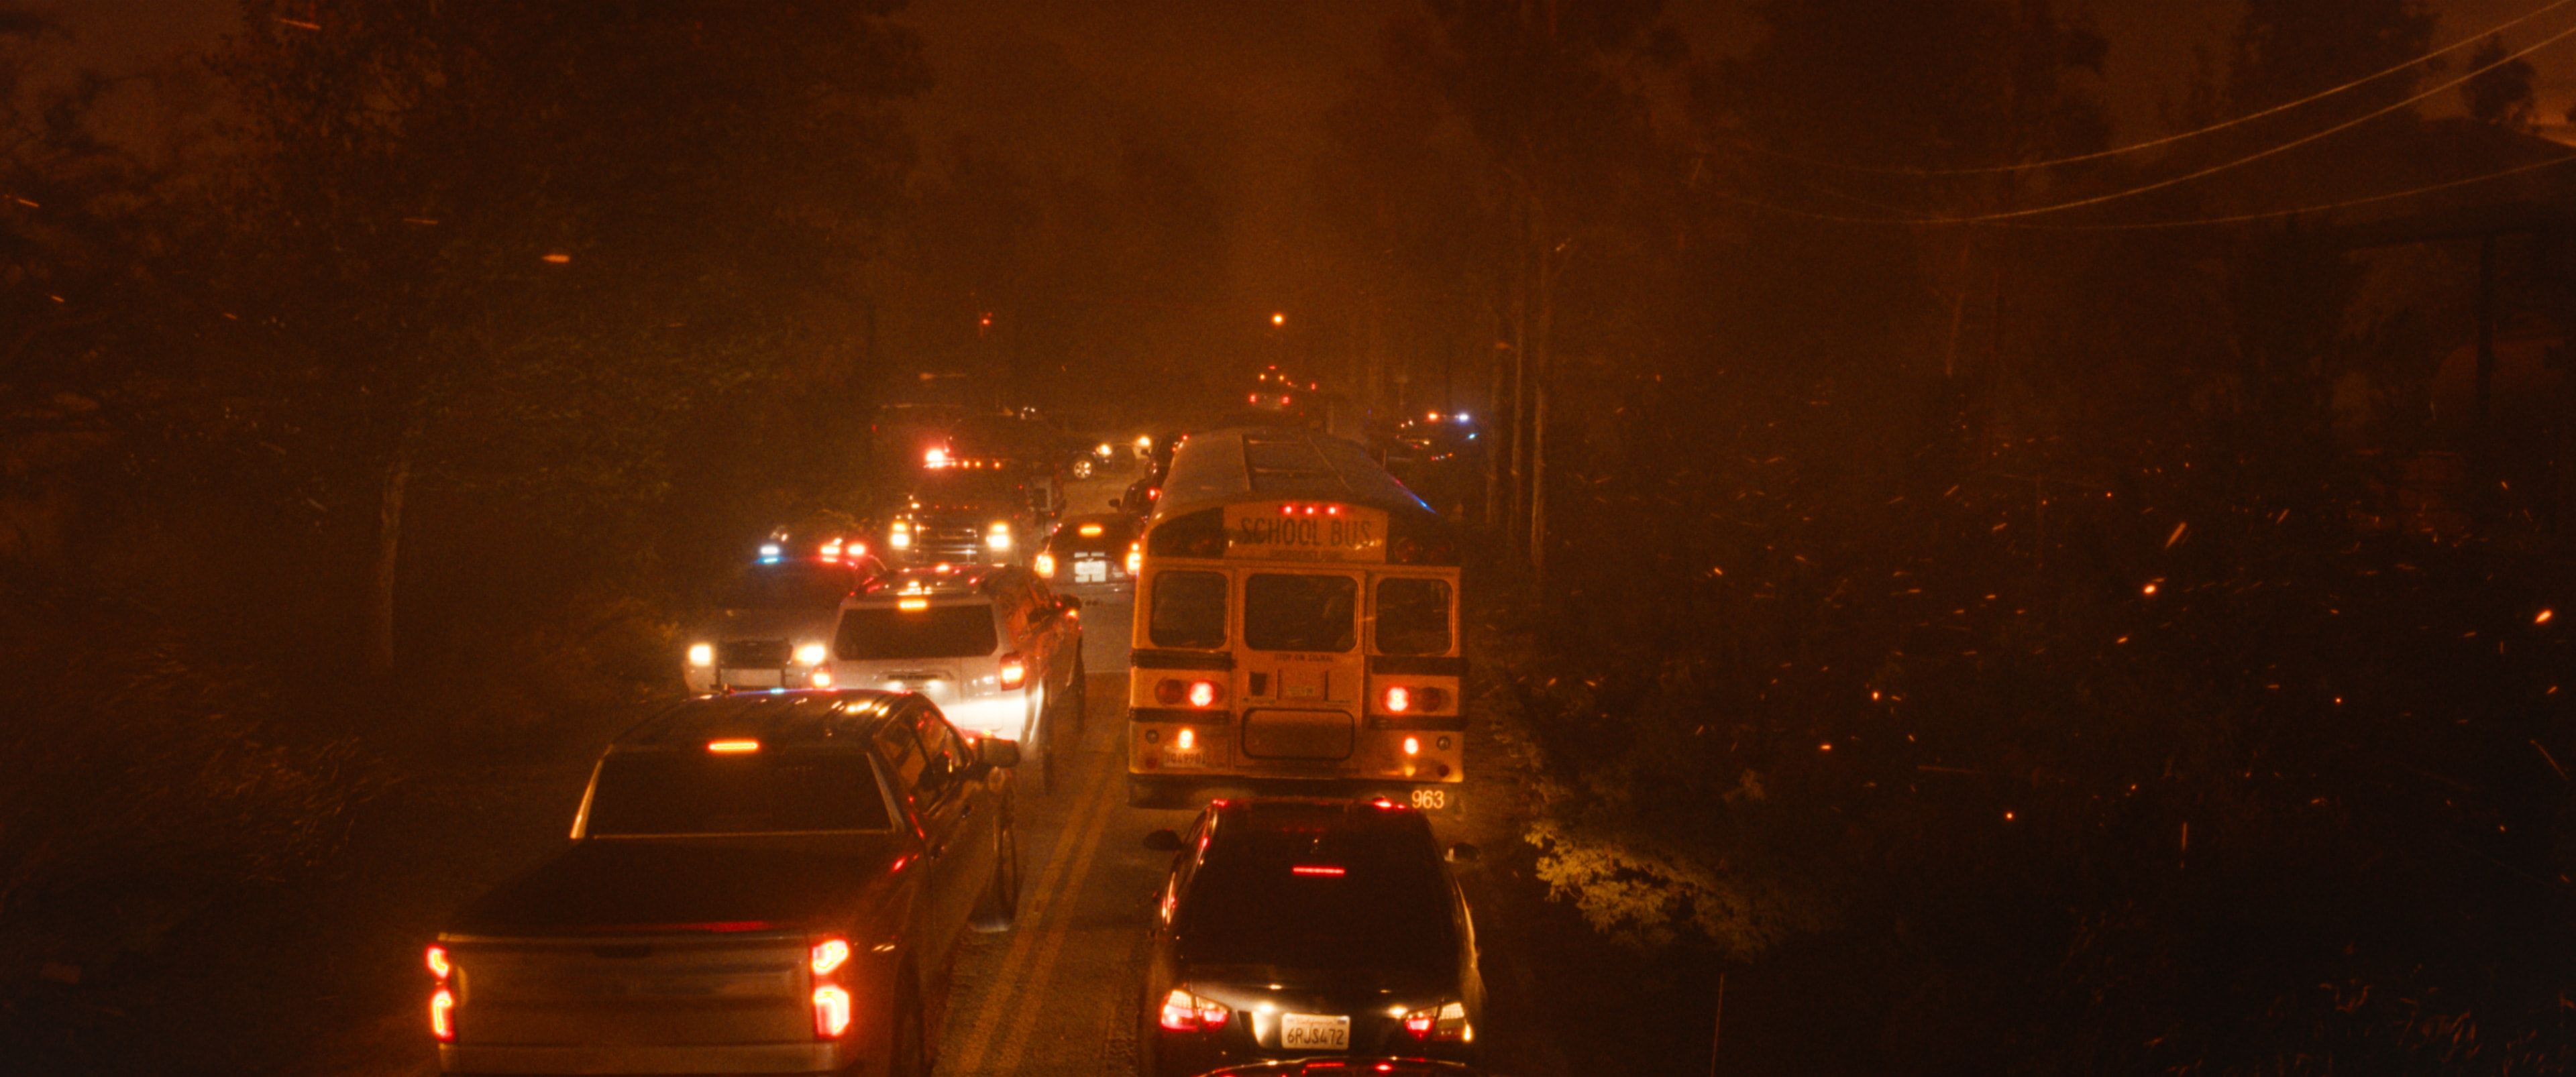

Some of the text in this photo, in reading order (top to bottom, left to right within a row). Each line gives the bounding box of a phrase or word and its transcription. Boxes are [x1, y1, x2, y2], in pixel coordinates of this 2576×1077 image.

[1240, 517, 1373, 548] SCHOOL BUS
[1411, 789, 1445, 809] 963
[1287, 1027, 1344, 1045] 6RJS472
